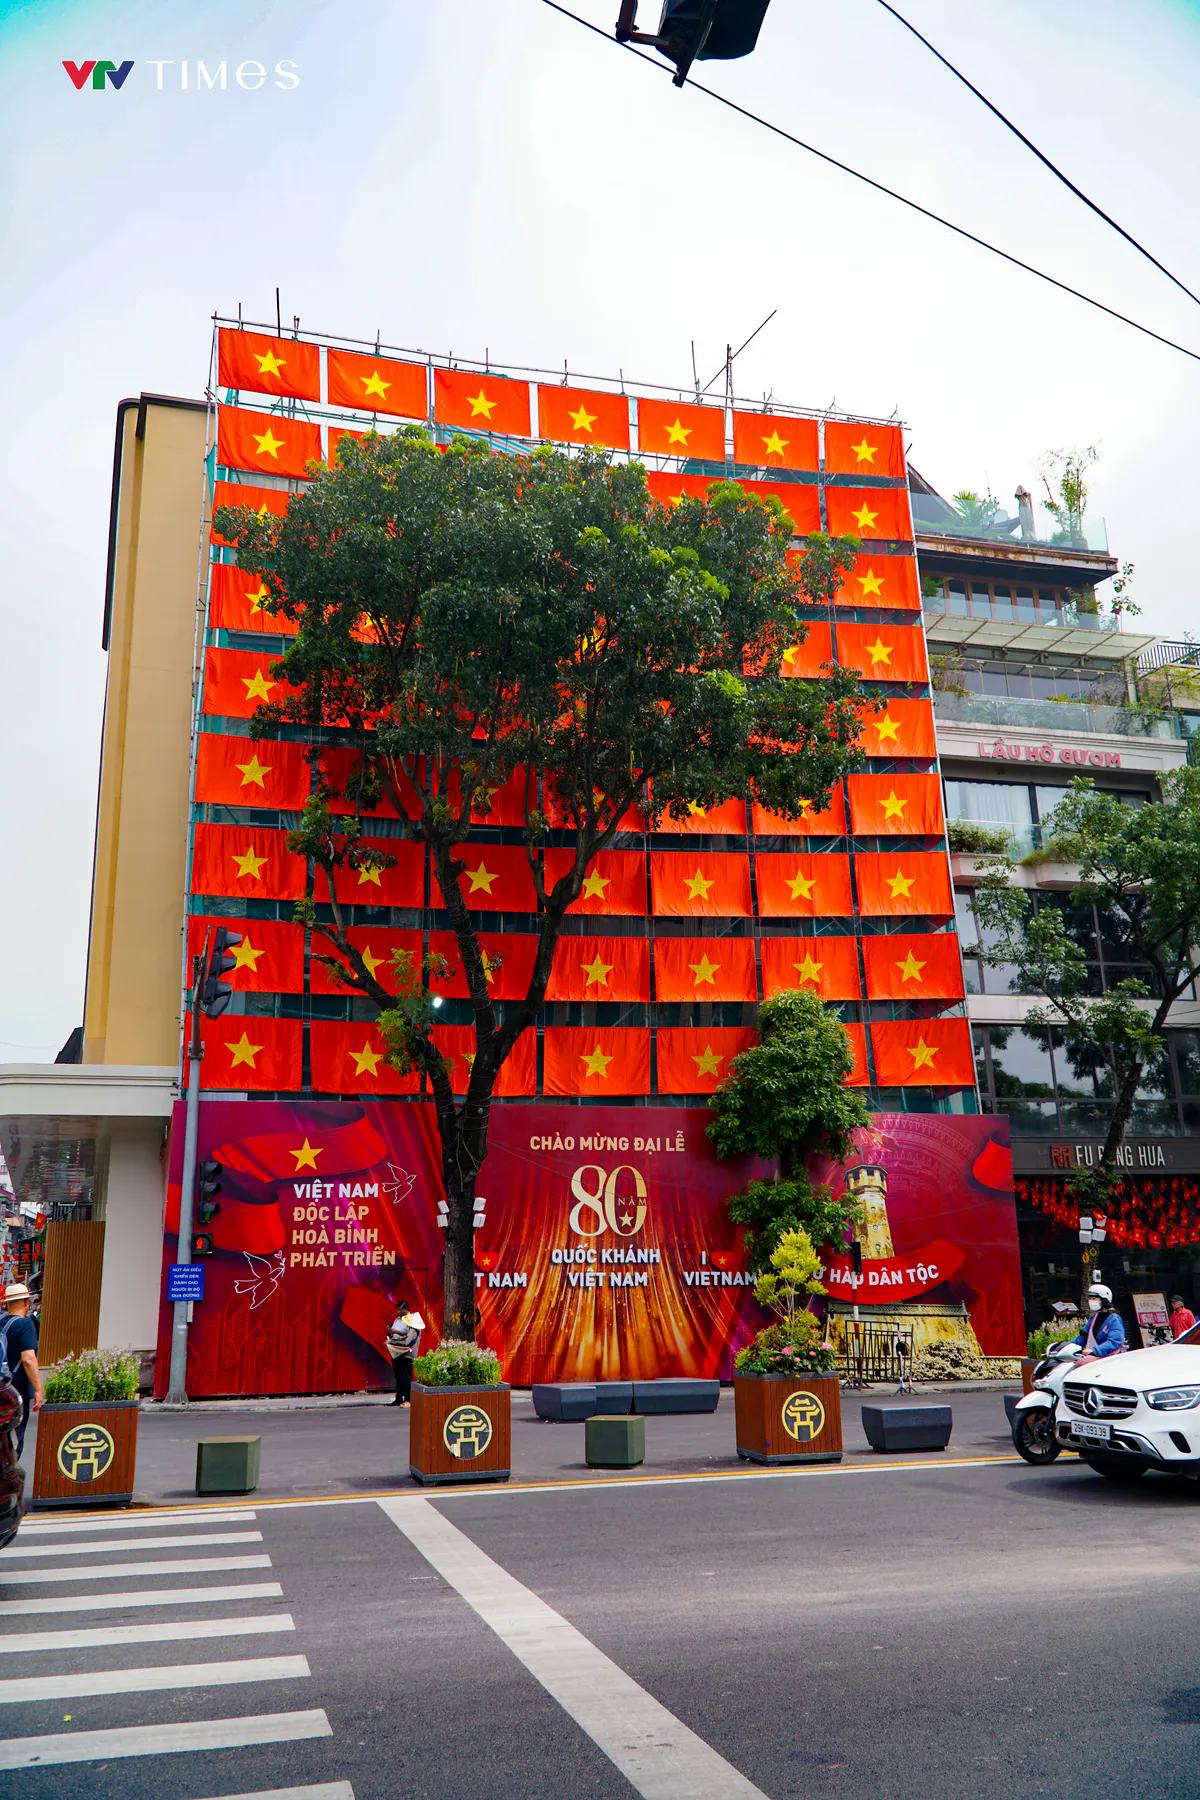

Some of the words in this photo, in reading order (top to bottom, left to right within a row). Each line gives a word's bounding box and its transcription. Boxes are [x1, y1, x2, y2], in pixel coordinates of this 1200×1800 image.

[1060, 748, 1121, 768] GƯƠM
[530, 1132, 575, 1151] CHÀO
[580, 1132, 629, 1151] MỪNG
[633, 1137, 661, 1155] ĐẠI
[665, 1130, 685, 1152] LỄ
[1075, 1145, 1094, 1166] FU
[1138, 1145, 1166, 1166] HUA
[293, 1179, 334, 1203] VIỆT
[338, 1183, 379, 1198] NAM
[569, 1164, 648, 1237] 80
[617, 1196, 647, 1206] NĂM
[293, 1202, 330, 1226] ĐỘC
[334, 1201, 370, 1225] LẬP
[292, 1224, 329, 1245] HOÀ
[334, 1224, 378, 1244] BÌNH
[290, 1247, 338, 1268] PHÁT
[342, 1244, 396, 1266] TRIỂN
[551, 1243, 598, 1264] QUỐC
[601, 1244, 660, 1264] KHÁNH
[701, 1250, 707, 1265] I
[488, 1272, 527, 1288] NAM
[568, 1267, 607, 1291] VIỆT
[610, 1271, 648, 1287] NAM
[683, 1271, 757, 1286] VIETNAM
[868, 1267, 904, 1286] DÂN
[905, 1262, 939, 1284] TỘC
